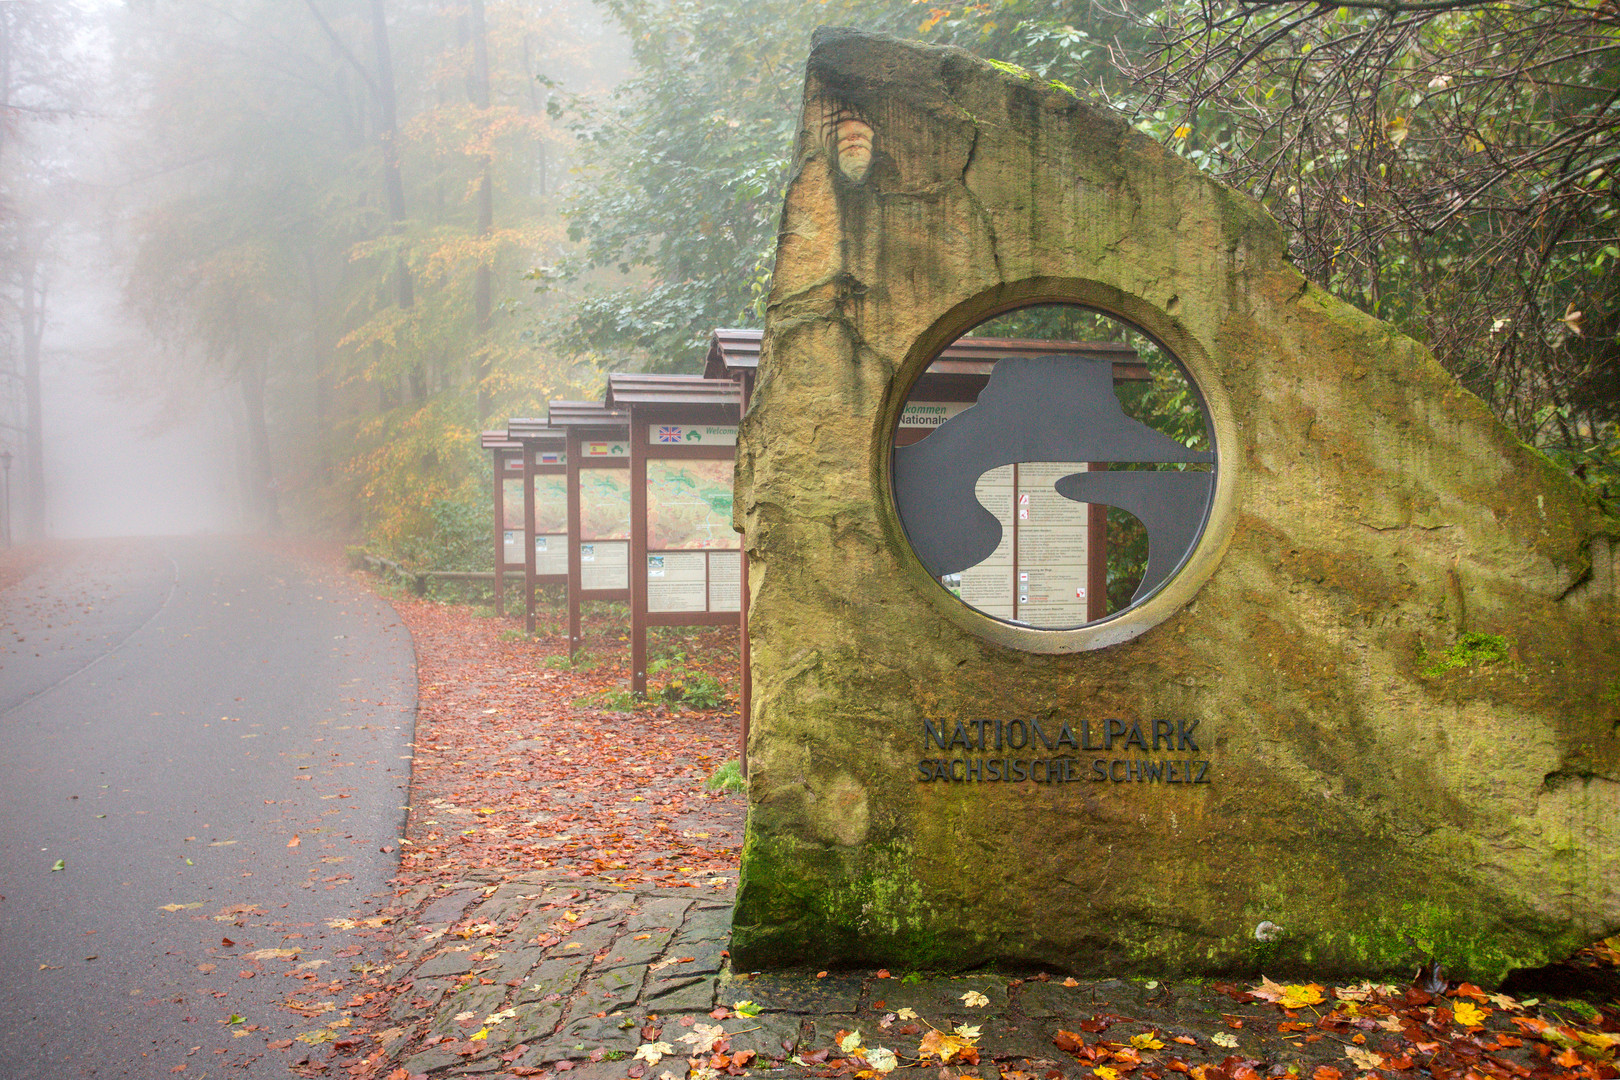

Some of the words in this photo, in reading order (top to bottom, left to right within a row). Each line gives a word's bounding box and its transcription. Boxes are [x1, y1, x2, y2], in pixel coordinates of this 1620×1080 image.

[923, 717, 1200, 750] NATIONALPARK
[917, 757, 1080, 783] SÄCHSISCHE
[1092, 758, 1211, 784] SCHWEIZ
